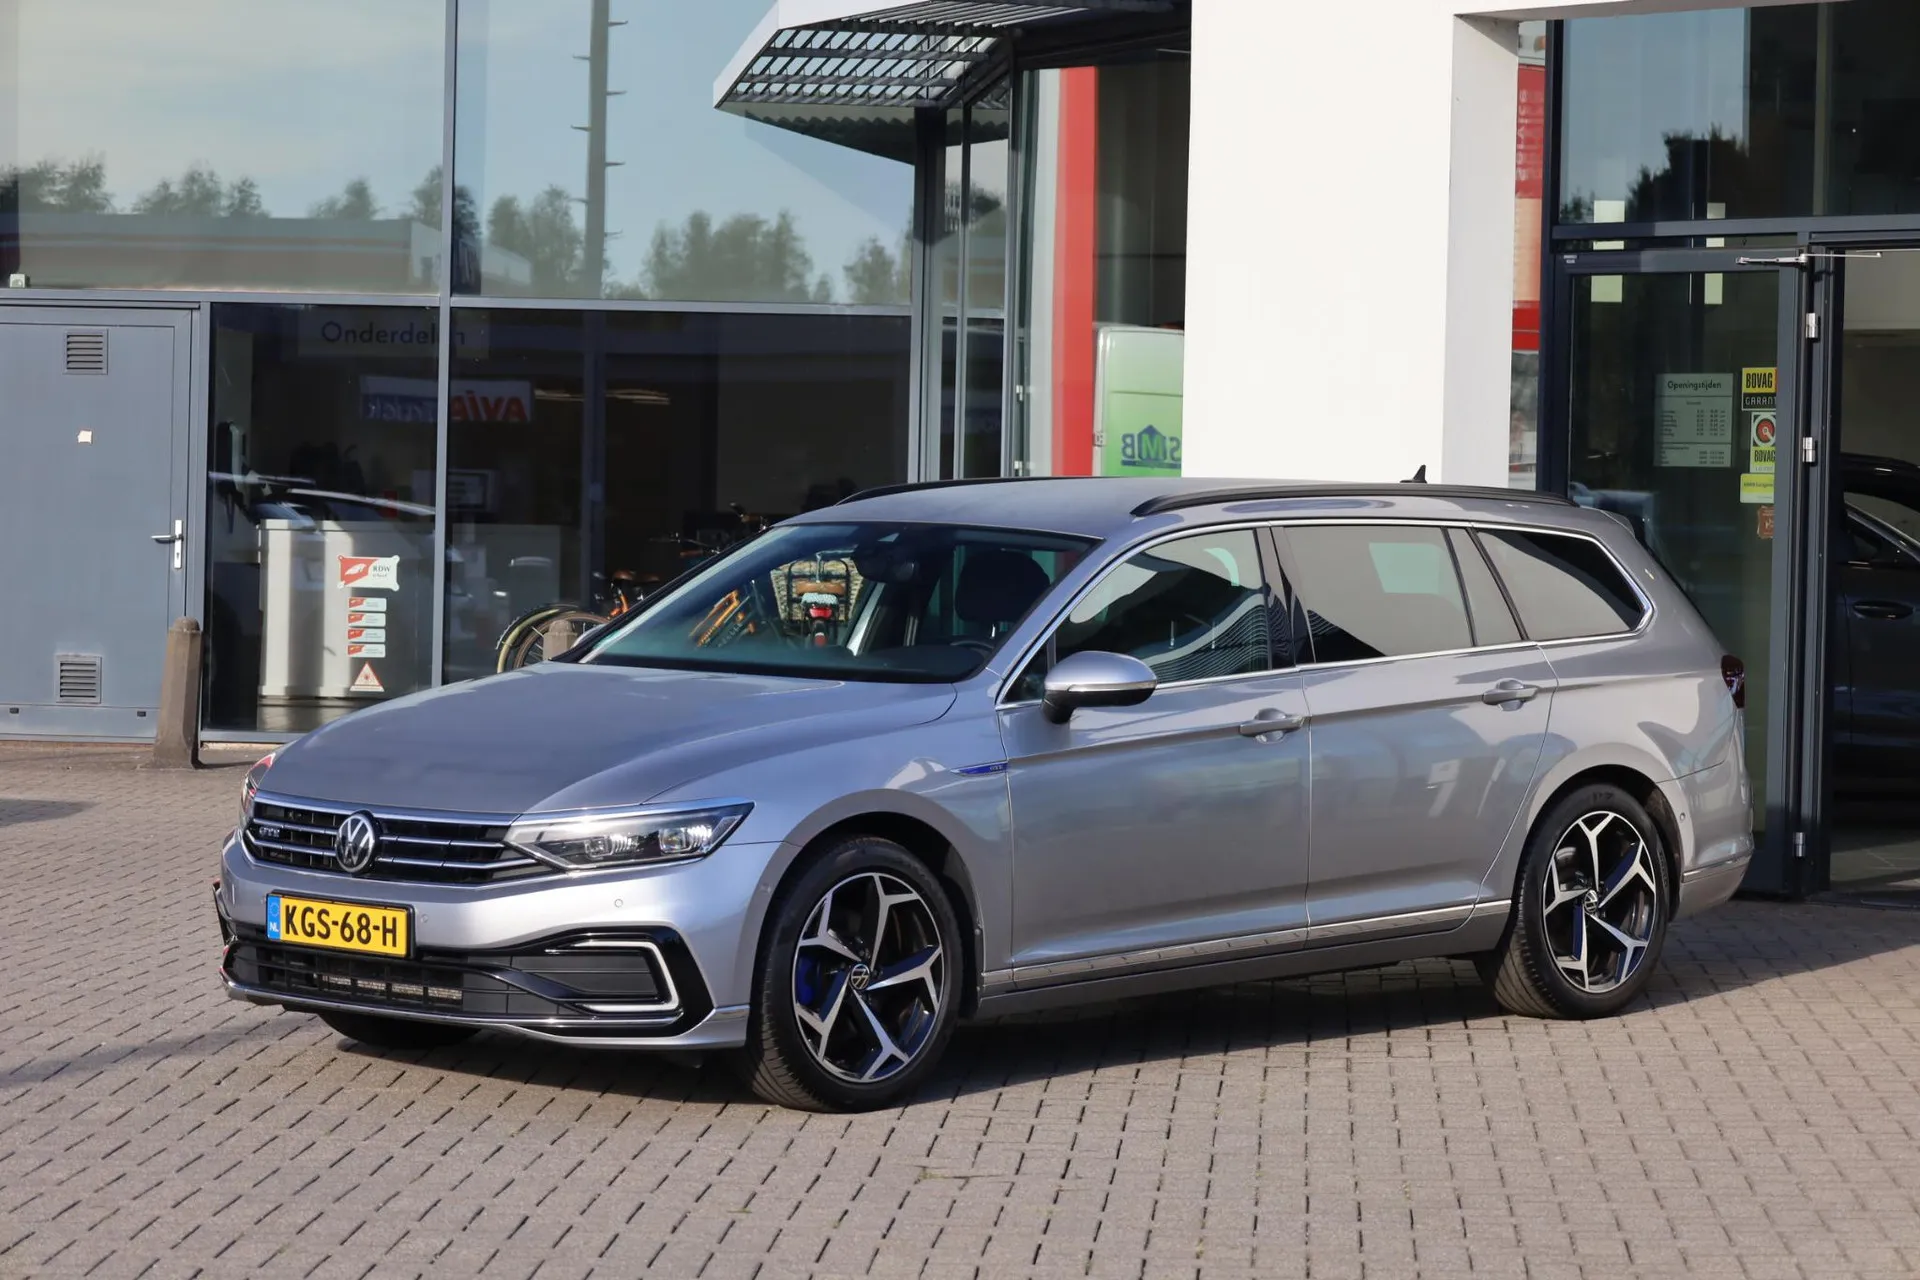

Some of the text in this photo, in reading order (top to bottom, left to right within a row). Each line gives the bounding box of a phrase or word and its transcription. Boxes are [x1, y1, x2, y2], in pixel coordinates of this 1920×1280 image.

[321, 320, 466, 345] Onderdeln
[1667, 379, 1722, 391] Openingstijden
[1745, 372, 1773, 389] BOVAG
[1754, 449, 1776, 462] BOVAG
[269, 922, 279, 932] NL
[284, 904, 398, 948] KGS-68-H
